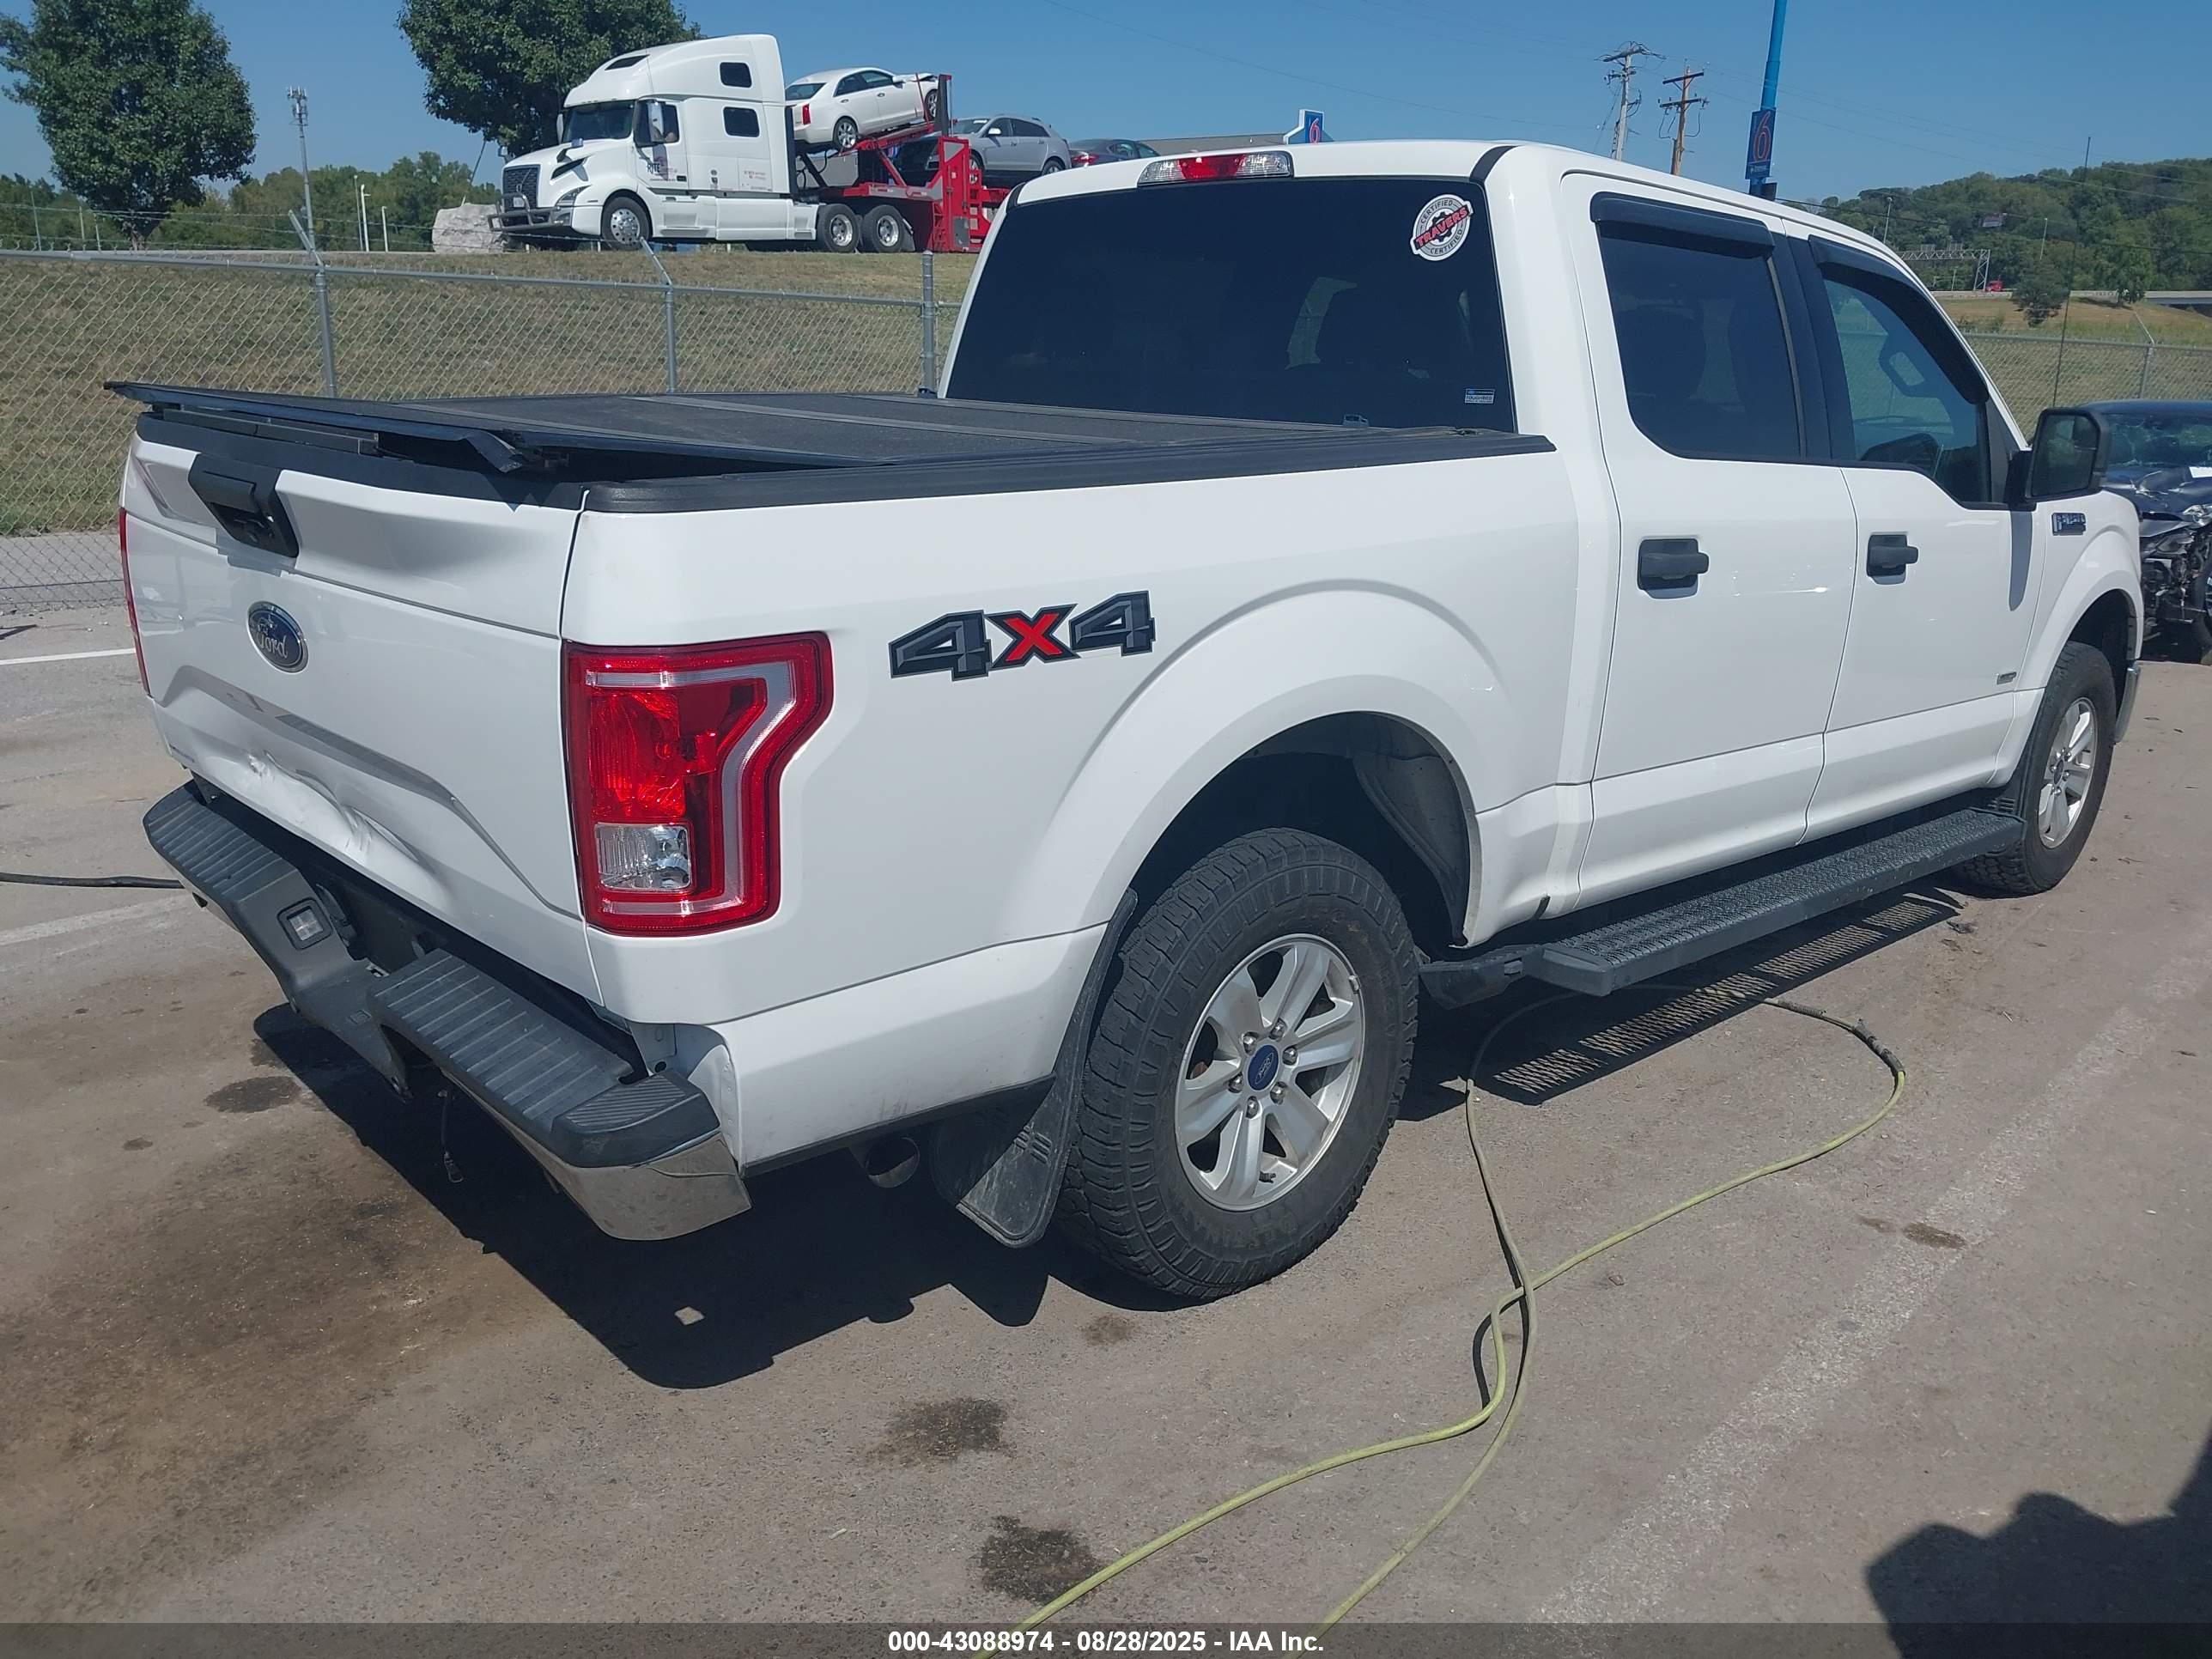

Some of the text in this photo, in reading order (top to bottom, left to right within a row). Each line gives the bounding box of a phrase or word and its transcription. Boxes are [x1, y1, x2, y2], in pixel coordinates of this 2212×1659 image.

[1310, 118, 1321, 143] 6
[1753, 111, 1771, 162] 6
[1416, 207, 1468, 246] TRAVERS
[1421, 200, 1454, 223] CERTIFIED
[1431, 229, 1463, 255] CERTIFIED
[256, 614, 289, 659] Ford
